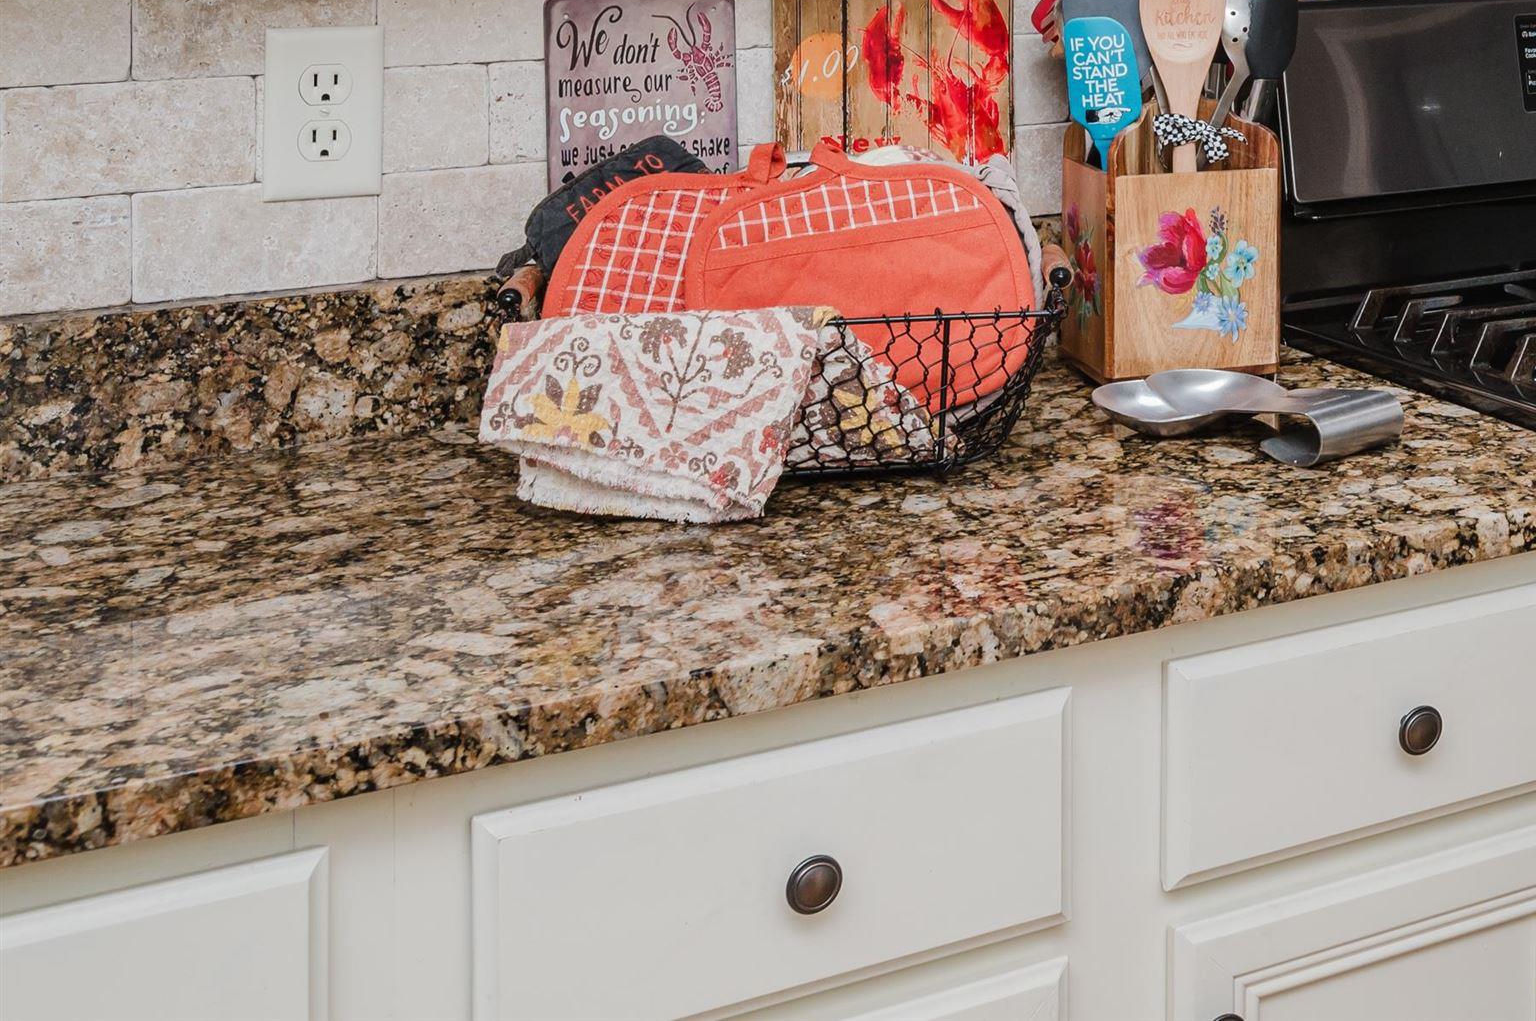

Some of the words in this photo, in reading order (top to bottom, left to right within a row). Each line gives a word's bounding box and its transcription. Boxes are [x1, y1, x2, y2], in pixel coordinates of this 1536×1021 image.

[556, 5, 623, 71] We
[613, 33, 660, 65] don't
[1070, 37, 1084, 52] IF
[1087, 33, 1125, 51] YOU
[1073, 48, 1125, 66] CAN'T
[1072, 63, 1128, 80] STAND
[558, 75, 642, 103] measure
[644, 73, 673, 94] our
[1084, 78, 1119, 94] THE
[1081, 91, 1125, 108] HEAT
[561, 147, 579, 167] we
[692, 136, 731, 157] shake
[634, 153, 664, 175] TO
